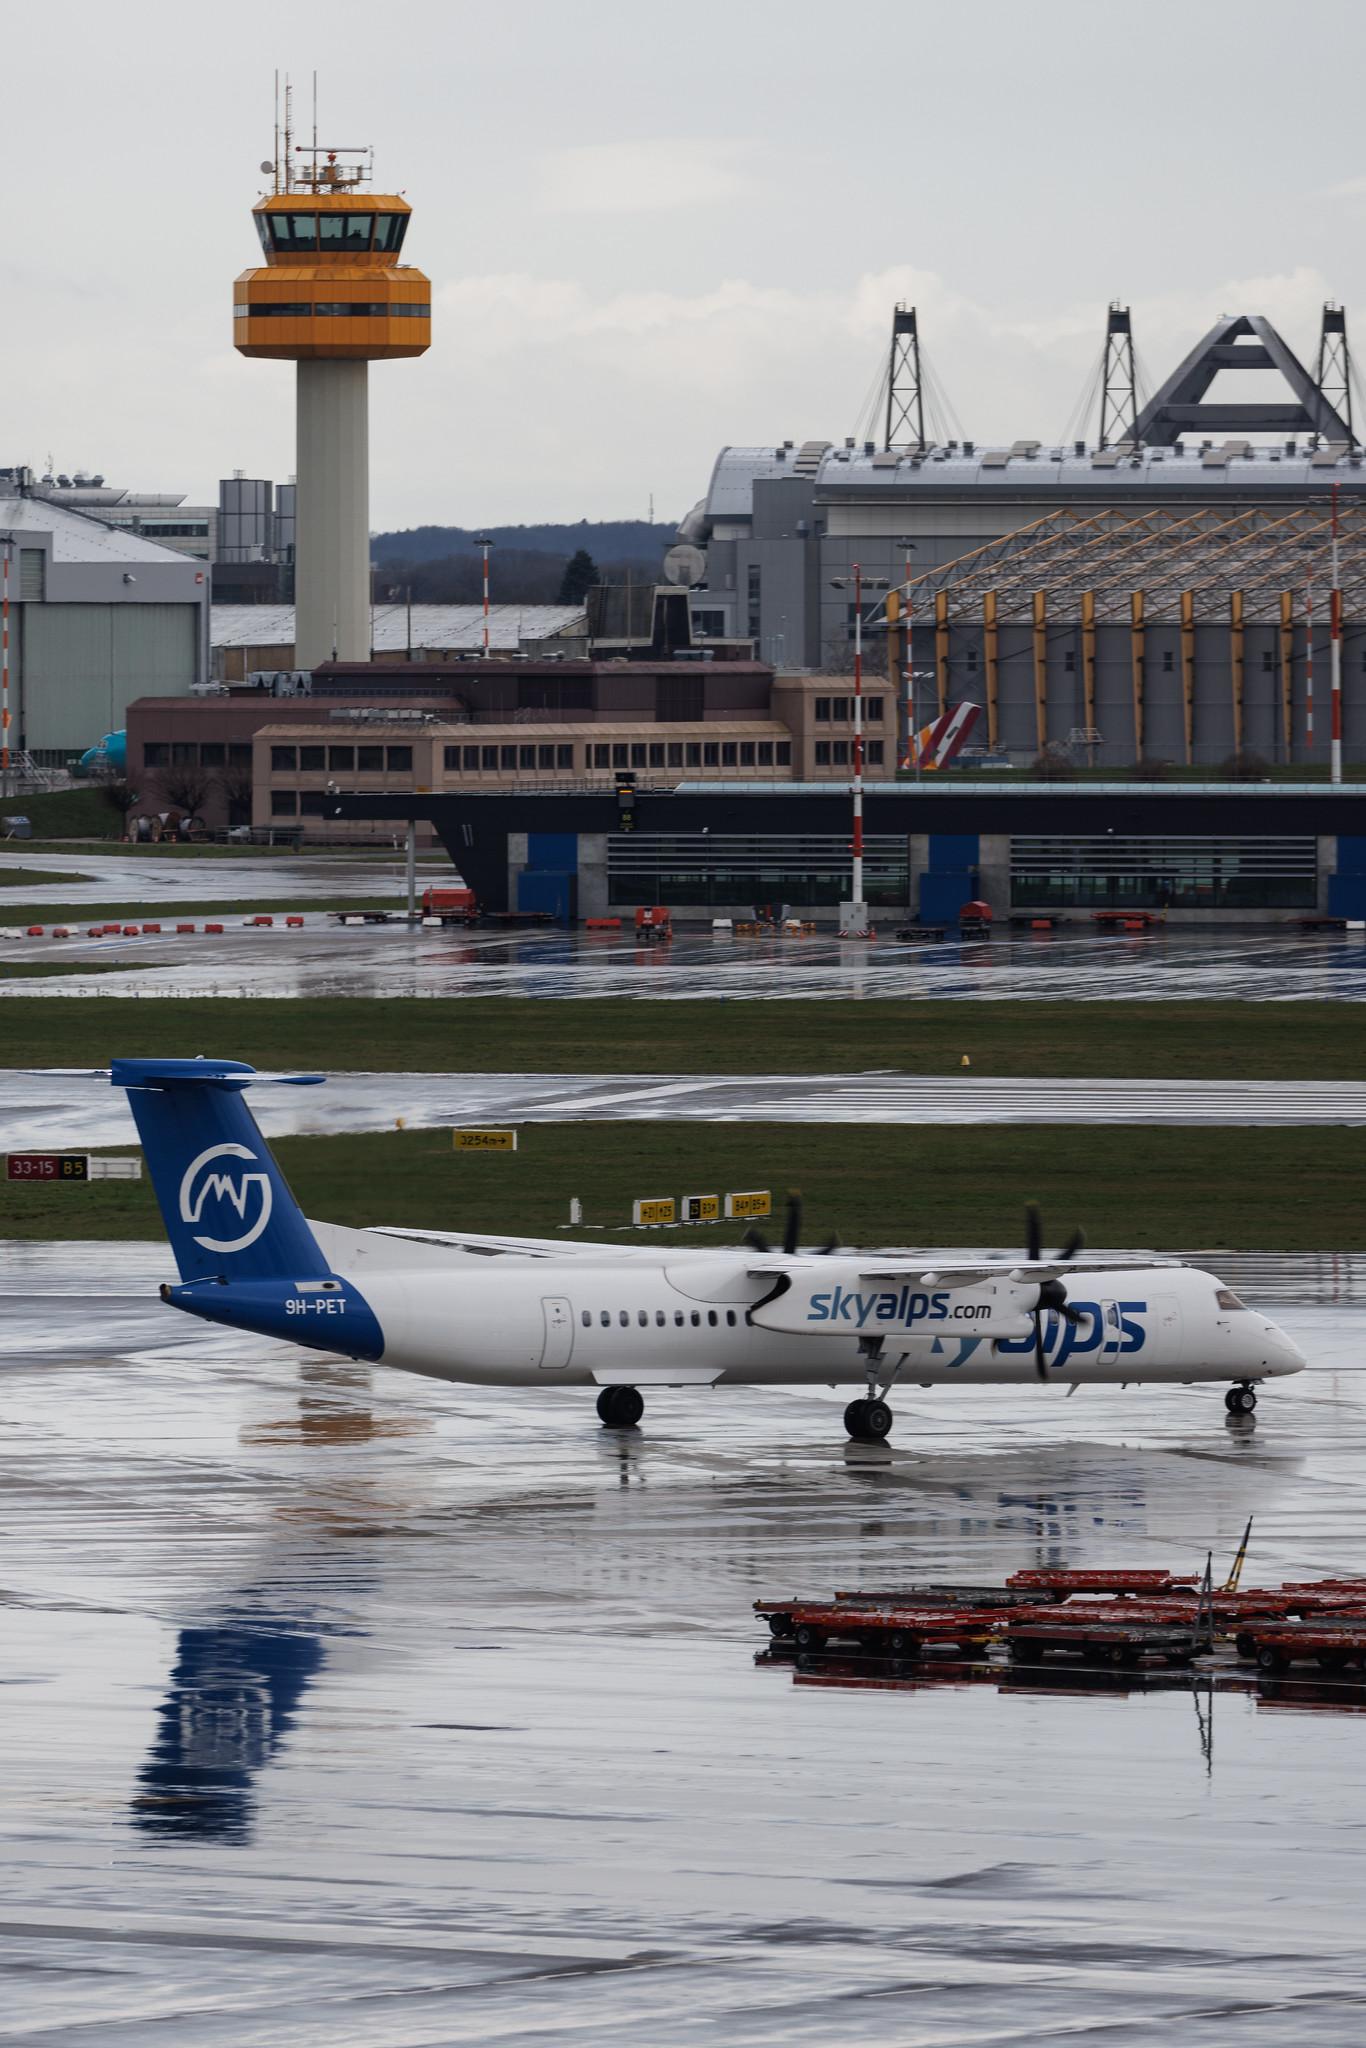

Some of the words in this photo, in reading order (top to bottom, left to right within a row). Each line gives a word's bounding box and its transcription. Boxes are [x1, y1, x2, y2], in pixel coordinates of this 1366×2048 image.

[13, 1161, 54, 1174] 33-15
[63, 1161, 84, 1174] B5
[285, 1299, 346, 1315] 9H-PET
[807, 1285, 991, 1327] skyalps.com
